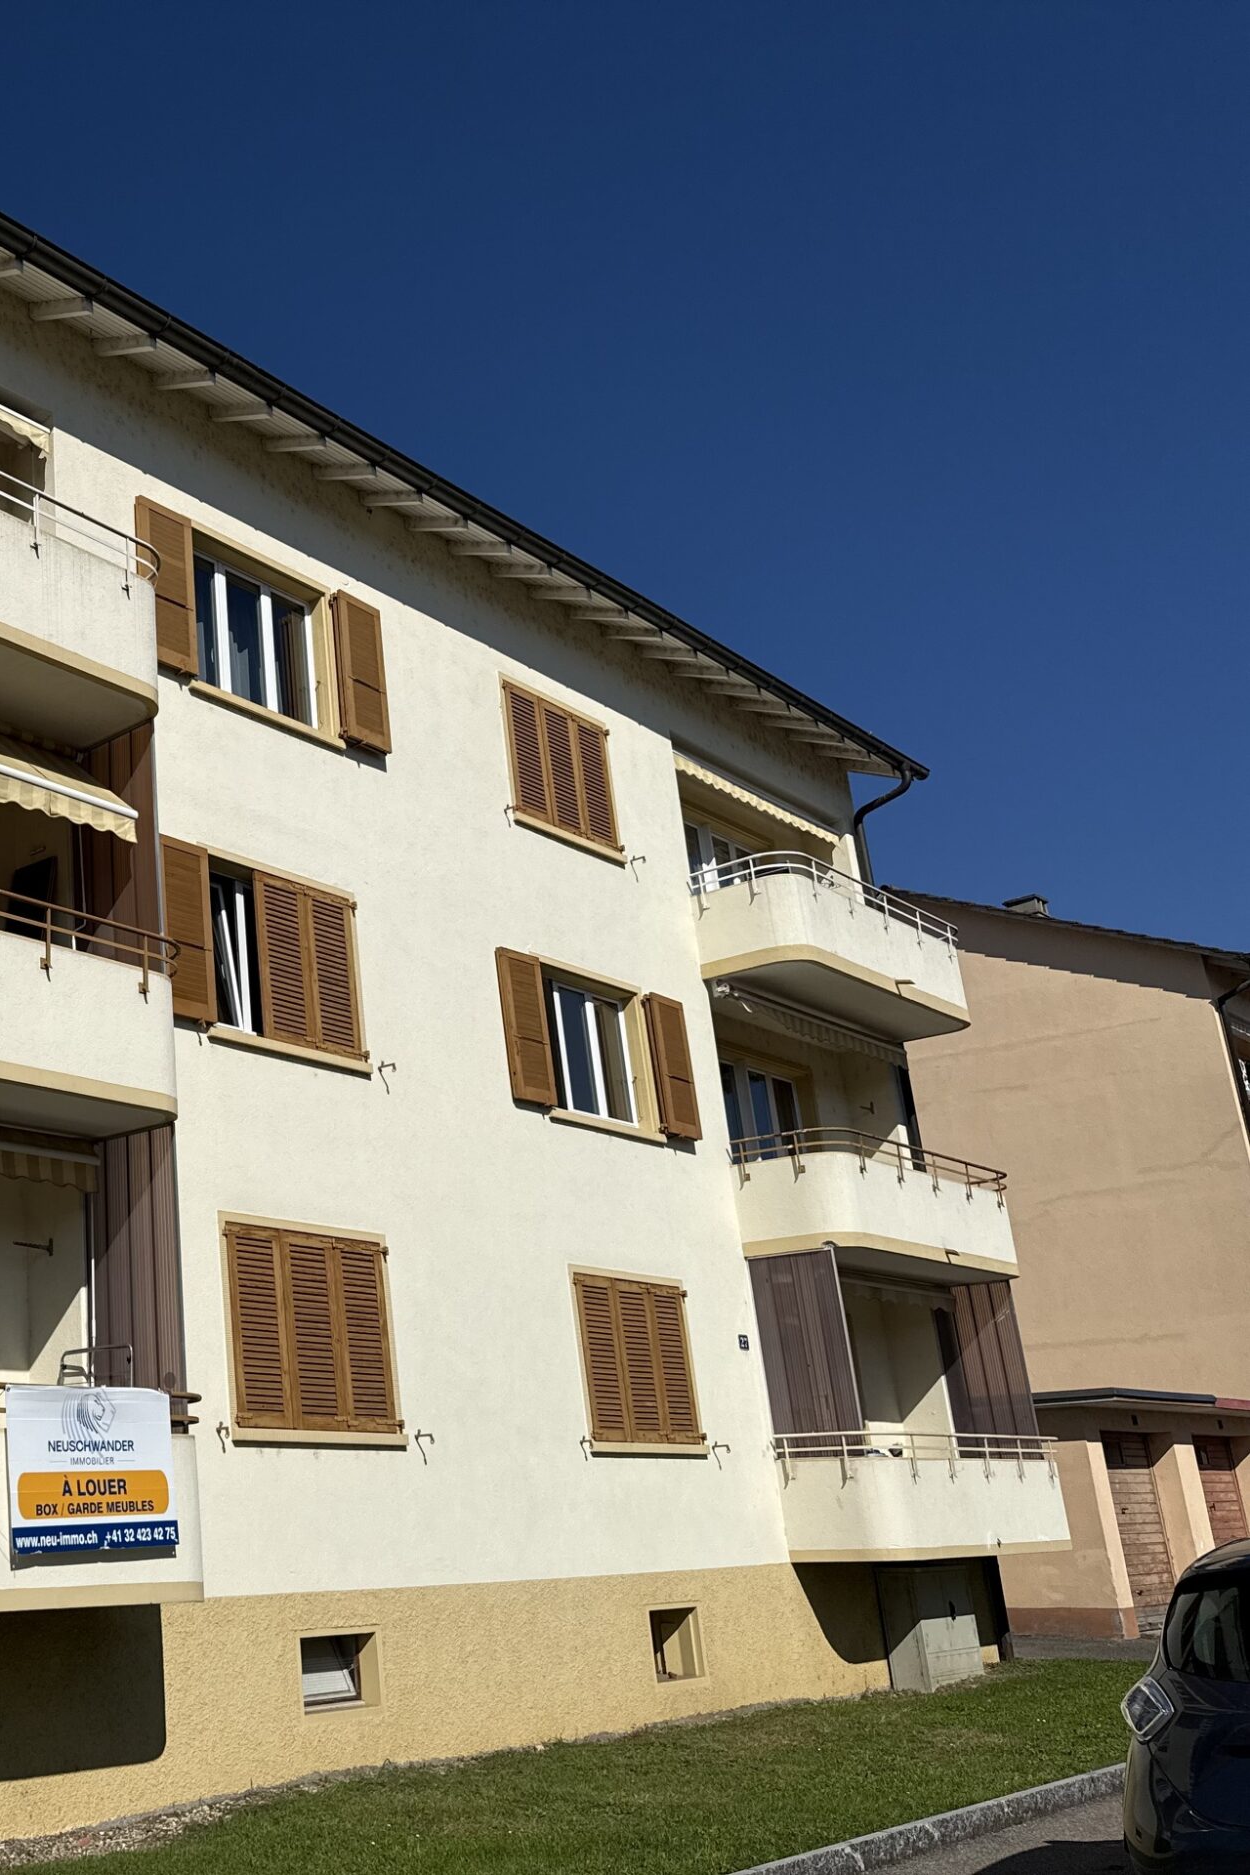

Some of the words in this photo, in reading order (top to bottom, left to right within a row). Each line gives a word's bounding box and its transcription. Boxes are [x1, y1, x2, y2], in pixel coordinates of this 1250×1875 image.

[48, 1440, 134, 1453] NEUSCHWANDER
[70, 1457, 114, 1466] IMMOBILIER
[62, 1475, 72, 1497] À
[77, 1479, 127, 1496] LOUER
[36, 1503, 58, 1516] BOX
[67, 1501, 103, 1514] GARDE
[106, 1500, 154, 1513] MEUBLES
[15, 1530, 98, 1548] www.neu-immo.ch
[105, 1529, 122, 1543] +41
[124, 1528, 135, 1541] 32
[136, 1528, 152, 1541] 423
[153, 1527, 163, 1540] 42
[165, 1526, 175, 1540] 75
